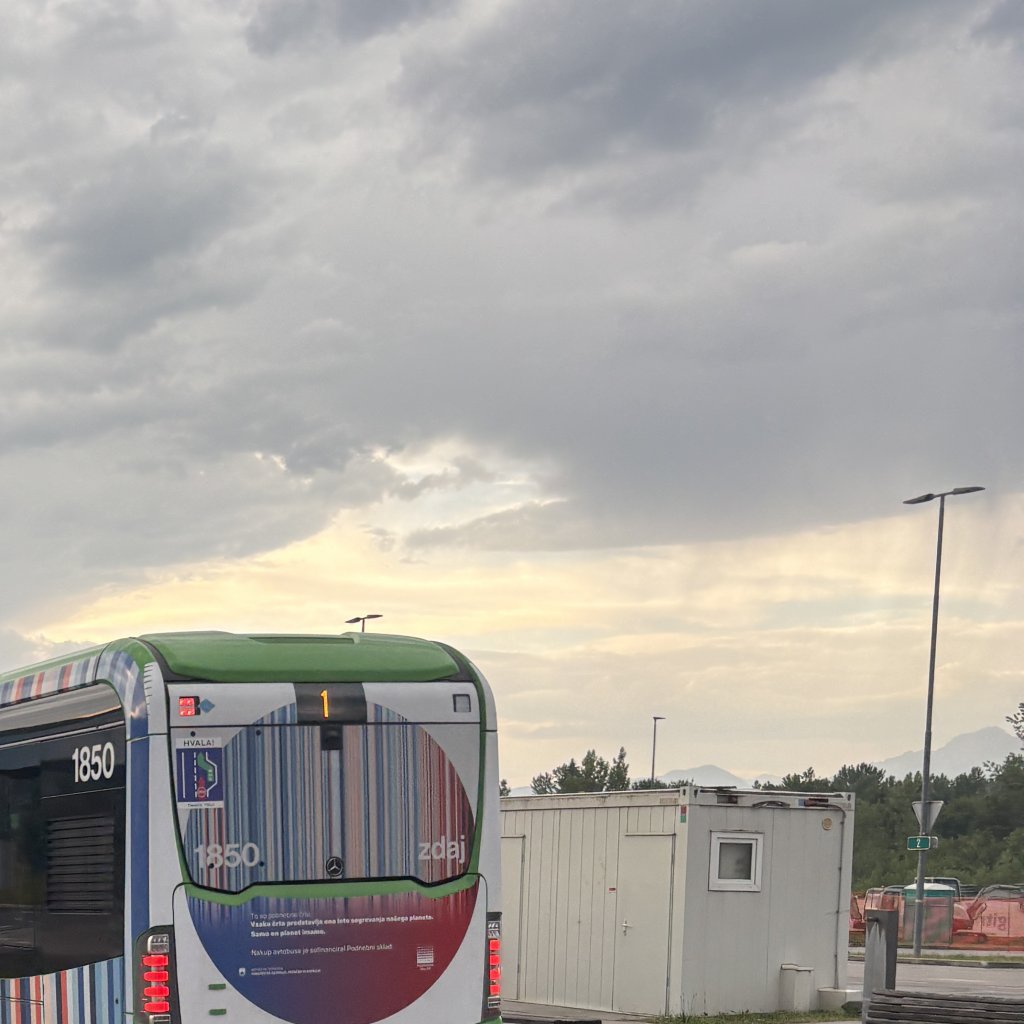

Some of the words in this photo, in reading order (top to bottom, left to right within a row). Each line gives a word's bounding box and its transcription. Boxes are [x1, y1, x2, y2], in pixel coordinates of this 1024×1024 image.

[320, 689, 329, 719] 1
[183, 739, 215, 747] HVALA!
[72, 741, 115, 783] 1850
[193, 842, 260, 869] 1850
[417, 835, 466, 864] zdaj
[916, 838, 921, 848] 2
